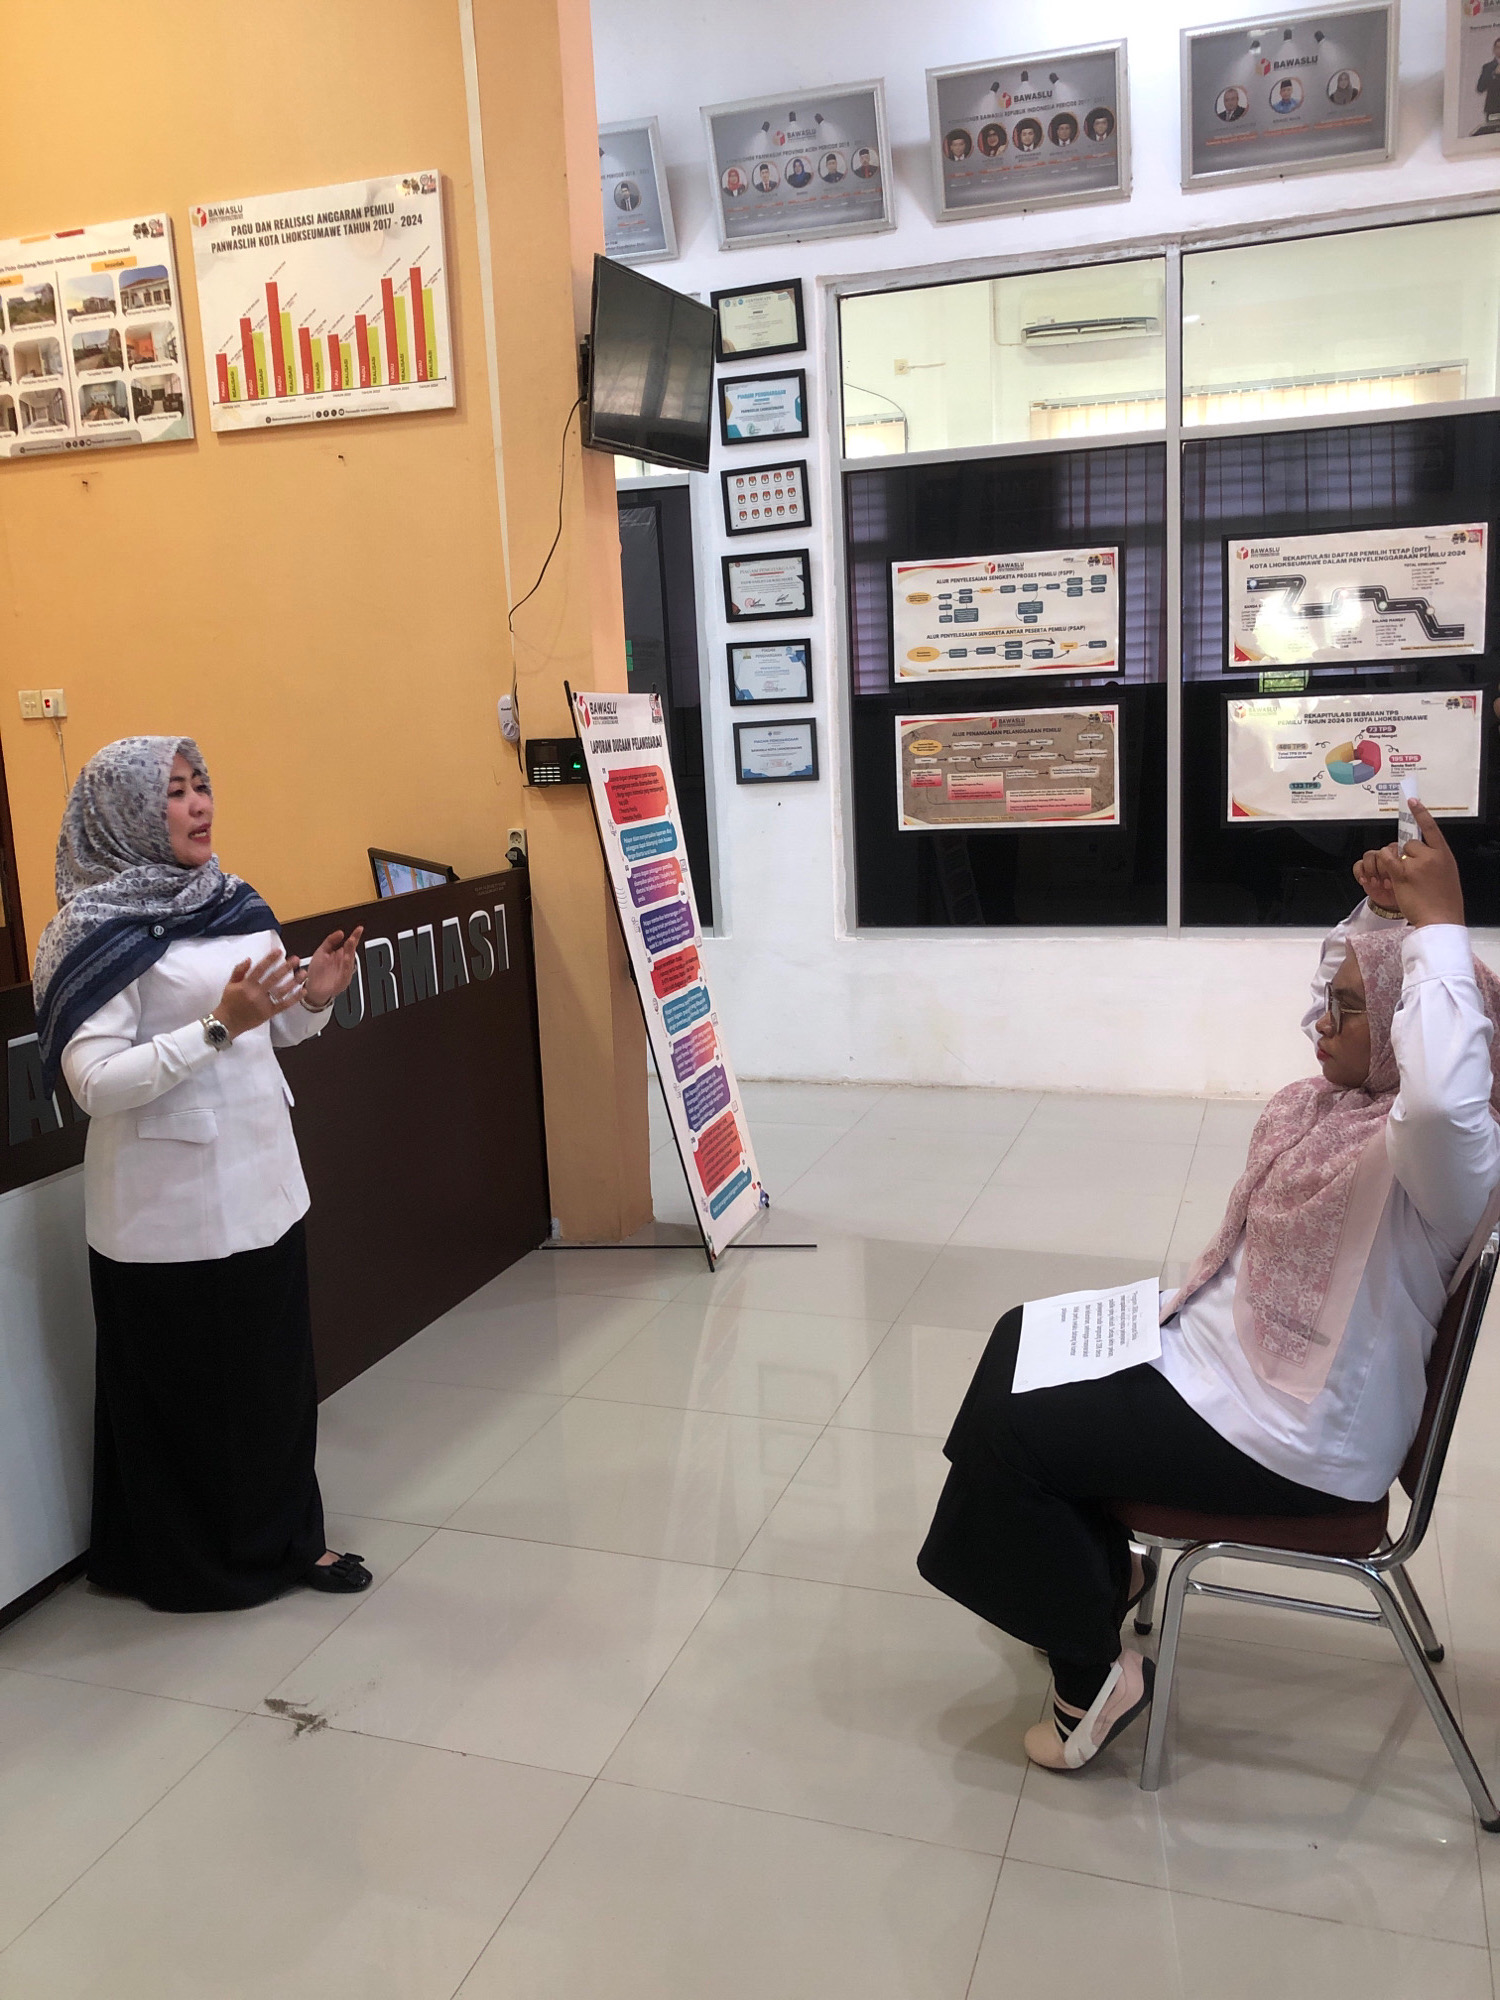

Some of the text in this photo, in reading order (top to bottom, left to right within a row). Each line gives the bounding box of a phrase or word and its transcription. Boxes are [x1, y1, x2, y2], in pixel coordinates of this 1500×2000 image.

[1274, 56, 1318, 68] BAWASLU
[1014, 91, 1052, 102] BAWASLU
[787, 129, 816, 138] BAWASLU
[208, 204, 243, 218] BAWASLU
[231, 203, 395, 236] PAGU DAN REALISASI ANGGARAN PEMILU
[211, 240, 256, 254] PANWASLIH
[259, 234, 280, 248] KOTA
[282, 224, 341, 244] LHOKSEUMAWE
[343, 221, 371, 236] TAHUN
[373, 218, 392, 231] 2017
[400, 214, 423, 228] 2024
[1283, 554, 1330, 562] REKAPITULASI
[1412, 546, 1431, 554] (DPT)
[1269, 560, 1320, 568] LHOKSEUMAWE
[1348, 554, 1418, 564] PENYELENGGARAAN
[950, 576, 988, 584] PENYELESAIAN
[589, 702, 618, 715] BAWASLU
[1374, 714, 1428, 722] LHOKSEUMAWE
[590, 739, 612, 754] LAPORAN
[612, 738, 632, 752] DUGAAN
